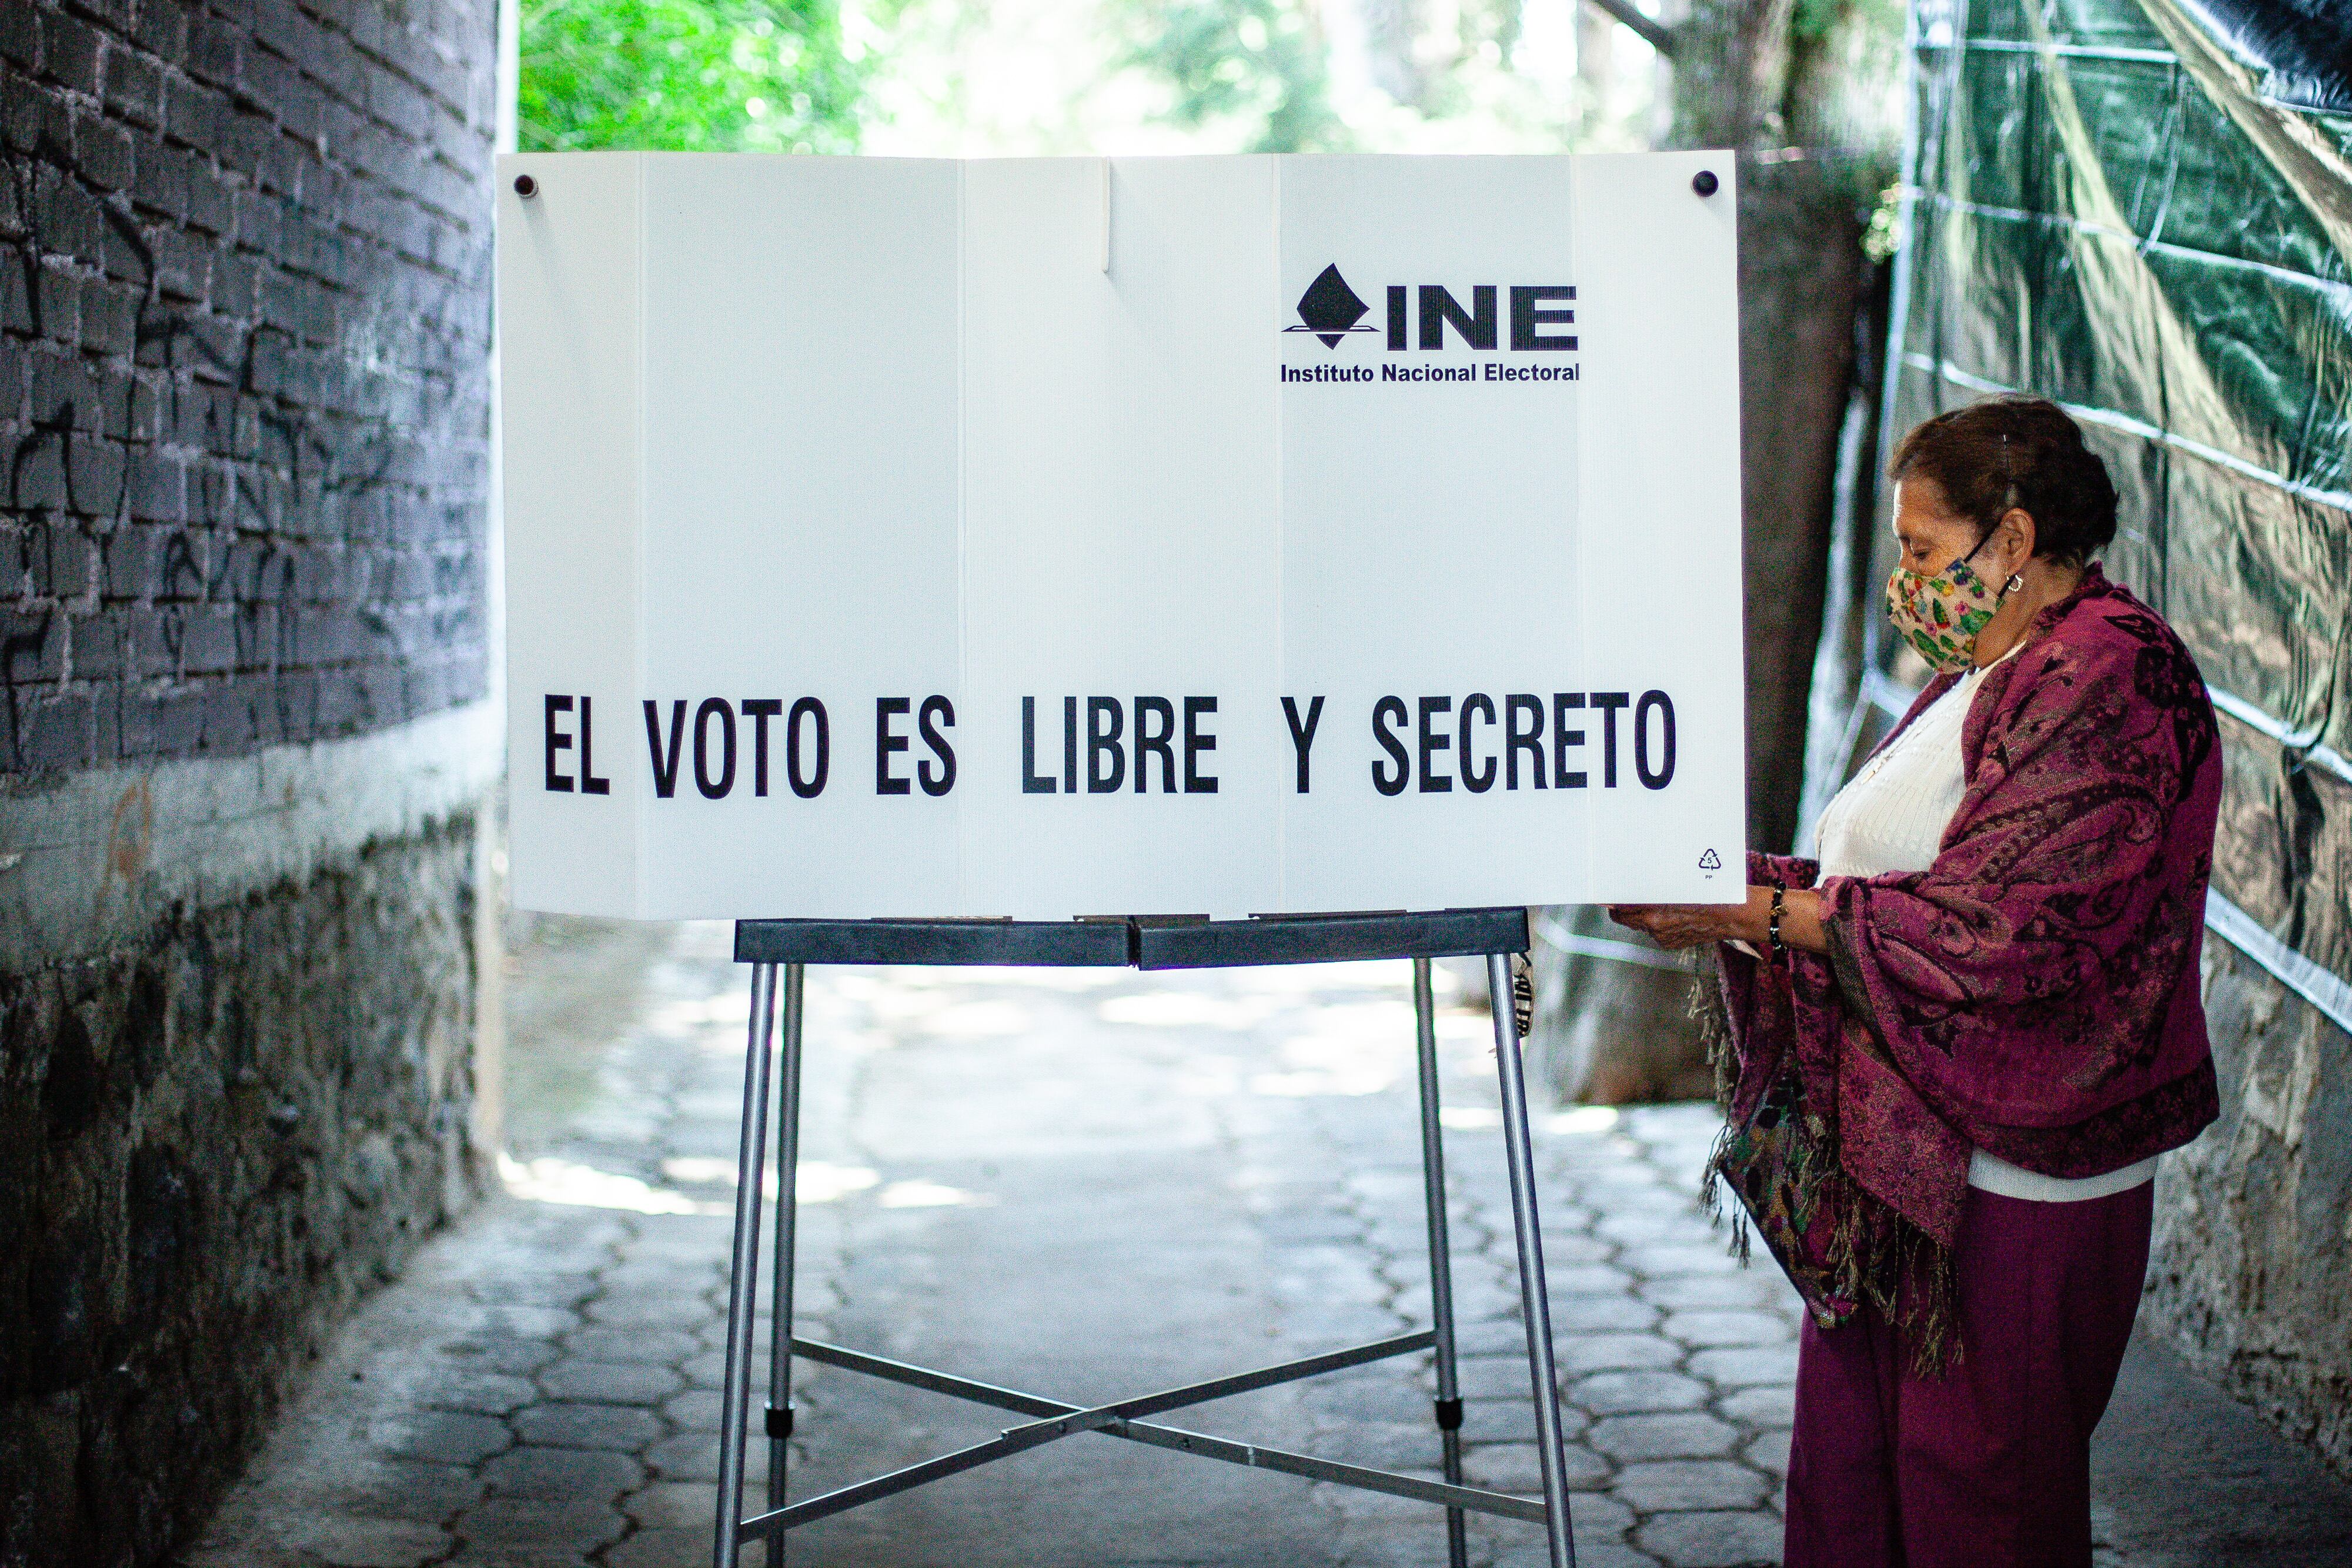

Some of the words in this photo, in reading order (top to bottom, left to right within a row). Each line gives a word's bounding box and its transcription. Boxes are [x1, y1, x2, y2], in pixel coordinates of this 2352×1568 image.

[1387, 285, 1579, 352] INE
[1281, 364, 1374, 383] Instituto
[1382, 363, 1474, 382] Nacional
[1484, 363, 1579, 381] Electoral
[544, 694, 610, 796] EL
[642, 696, 830, 800] VOTO
[876, 696, 957, 797] ES
[1022, 696, 1218, 794] LIBRE
[1279, 695, 1325, 794] Y
[1371, 689, 1676, 797] SECRETO
